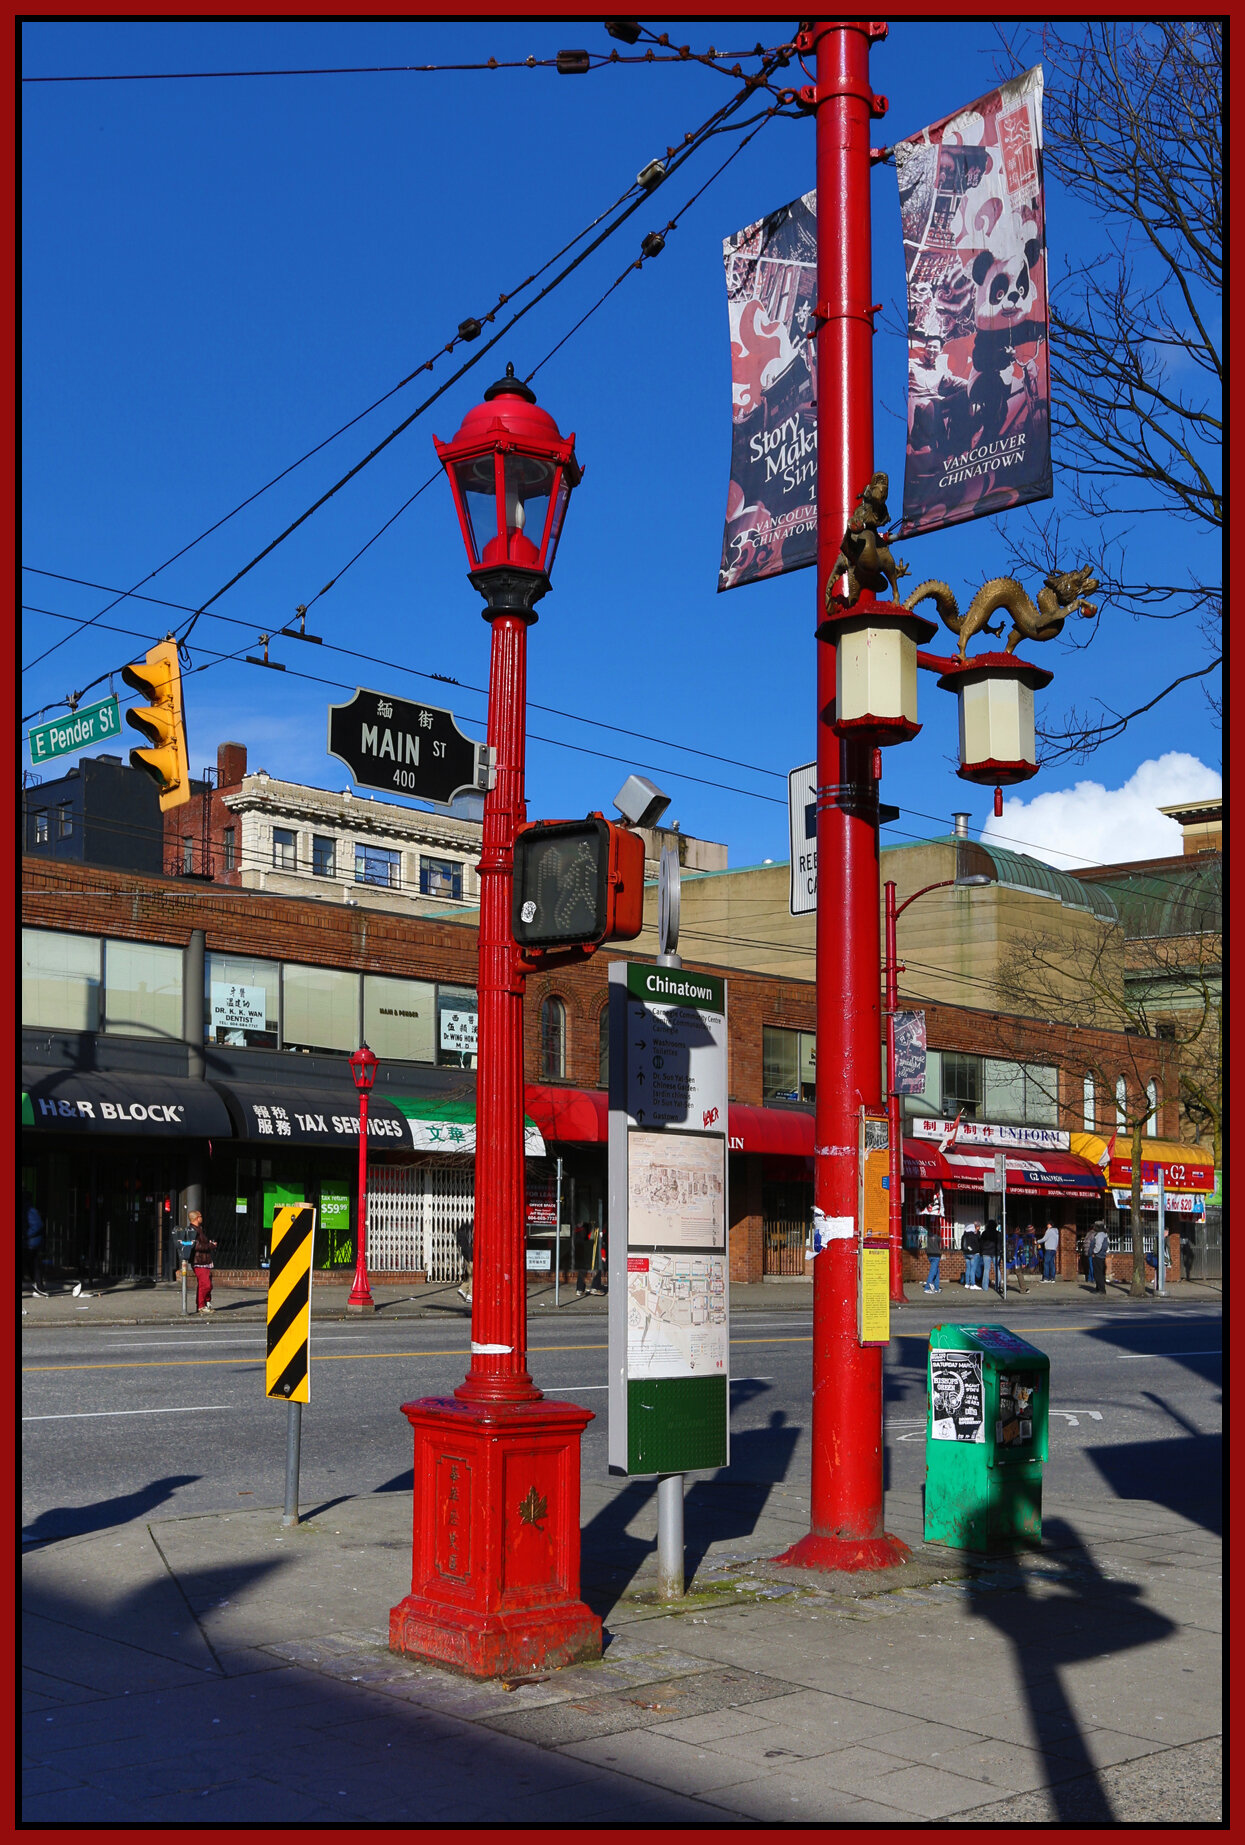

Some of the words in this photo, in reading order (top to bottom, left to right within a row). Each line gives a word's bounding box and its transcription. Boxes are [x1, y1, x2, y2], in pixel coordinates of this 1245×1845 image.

[750, 412, 800, 464] Story
[765, 420, 818, 483] Maki
[943, 433, 1026, 472] VANCOUVER
[783, 459, 818, 494] Sin
[939, 451, 1025, 488] CHINATOWN
[756, 504, 818, 532] VANCOUVE
[752, 519, 818, 548] CHINATOW
[36, 733, 46, 756] E
[50, 719, 94, 752] Pender
[99, 706, 114, 732] St
[361, 722, 420, 767] MAIN
[432, 740, 447, 758] ST
[392, 769, 416, 789] 400
[646, 975, 712, 1000] Chinatown
[215, 1006, 226, 1014] DR.
[226, 1015, 253, 1023] DENTIST
[708, 1015, 721, 1024] Centre
[450, 1033, 463, 1041] WING
[653, 1039, 686, 1049] Washrooms
[653, 1081, 676, 1090] Chinese
[677, 1083, 696, 1092] Garden
[38, 1097, 96, 1119] H&R
[653, 1112, 679, 1120] Gastown
[295, 1113, 329, 1133] TAX
[332, 1115, 403, 1137] SERICES
[1000, 1127, 1060, 1142] UNIFORM
[1029, 1173, 1040, 1181] G2
[1170, 1164, 1185, 1180] G2
[1166, 1198, 1171, 1210] 5
[1180, 1198, 1192, 1211] $20
